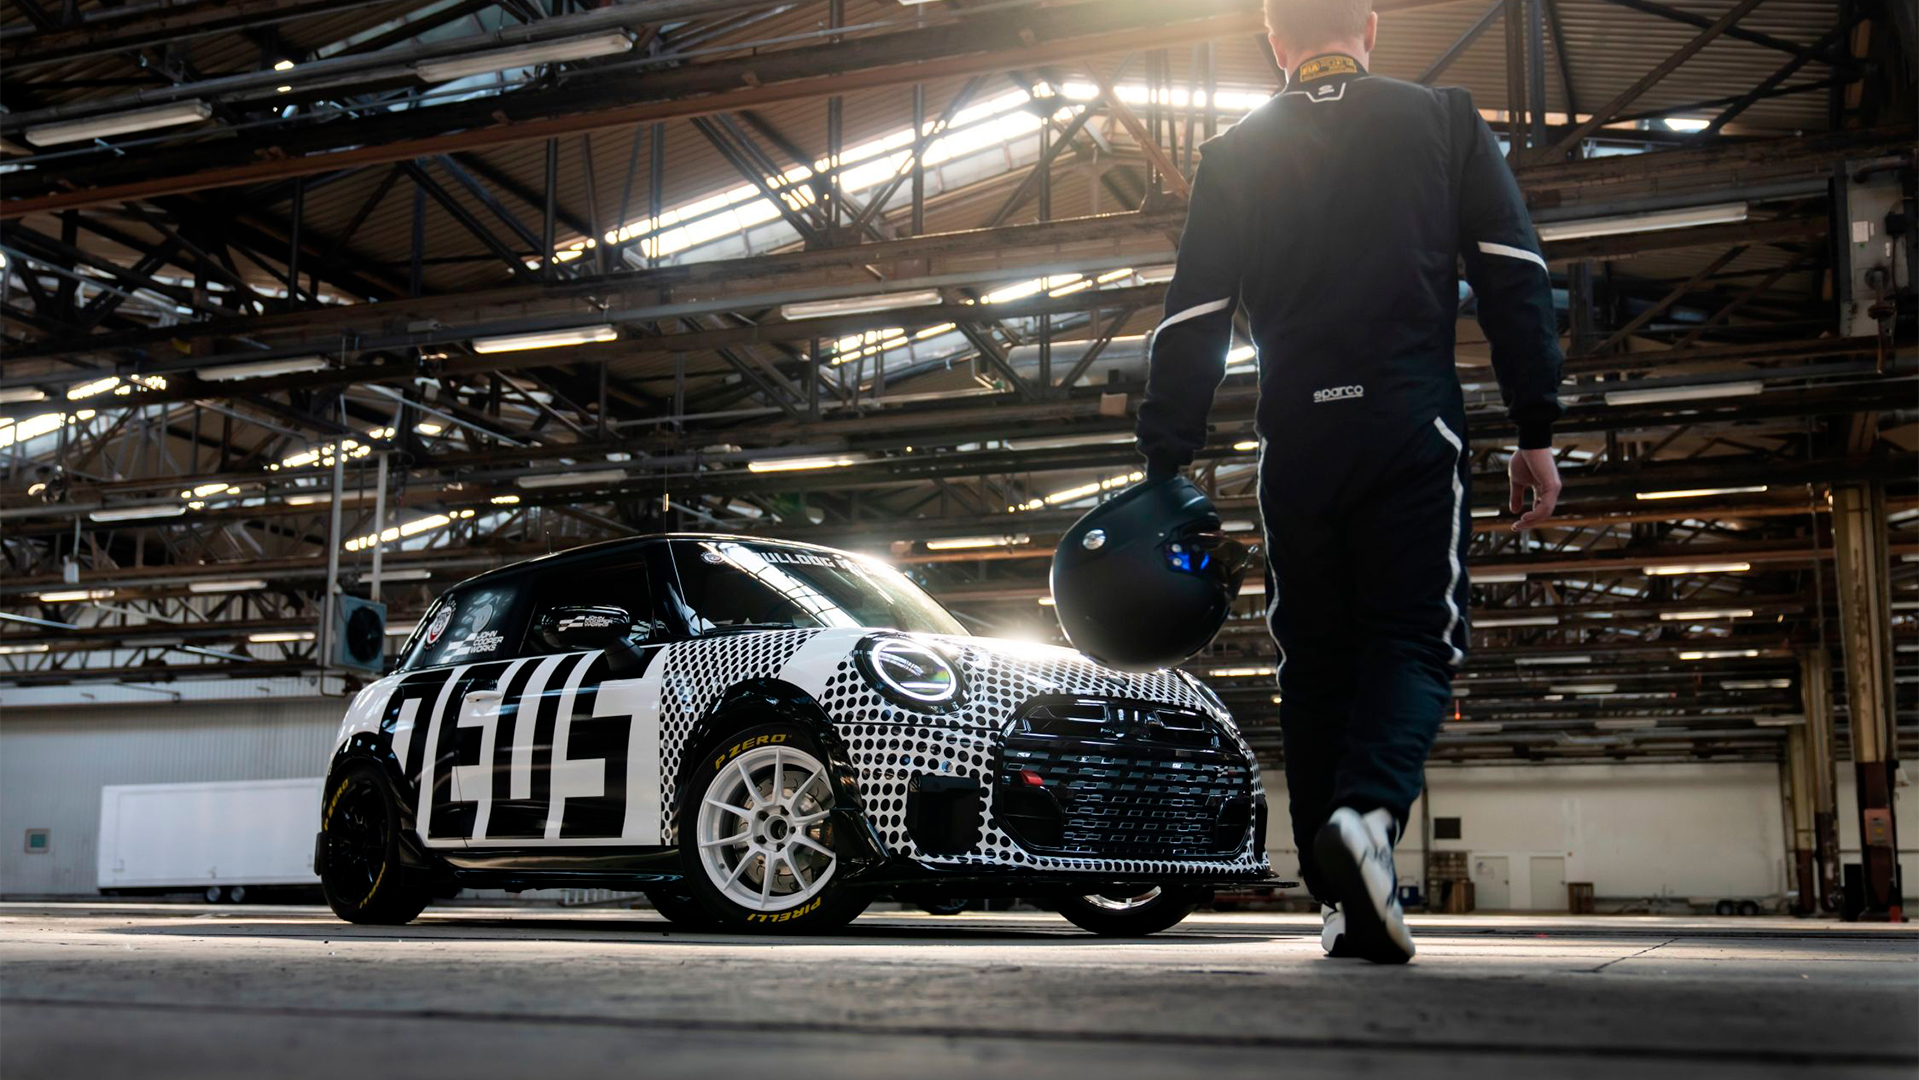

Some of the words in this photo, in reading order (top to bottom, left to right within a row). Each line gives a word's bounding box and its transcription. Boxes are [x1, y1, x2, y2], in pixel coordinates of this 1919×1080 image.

[1313, 384, 1364, 402] sparco
[755, 551, 836, 568] ULLDOG
[473, 636, 504, 646] COOPER
[476, 630, 498, 639] JOHN
[470, 644, 497, 653] WORKS
[715, 753, 726, 770] P
[728, 733, 787, 758] ZERO
[746, 896, 822, 923] PIRELLI
